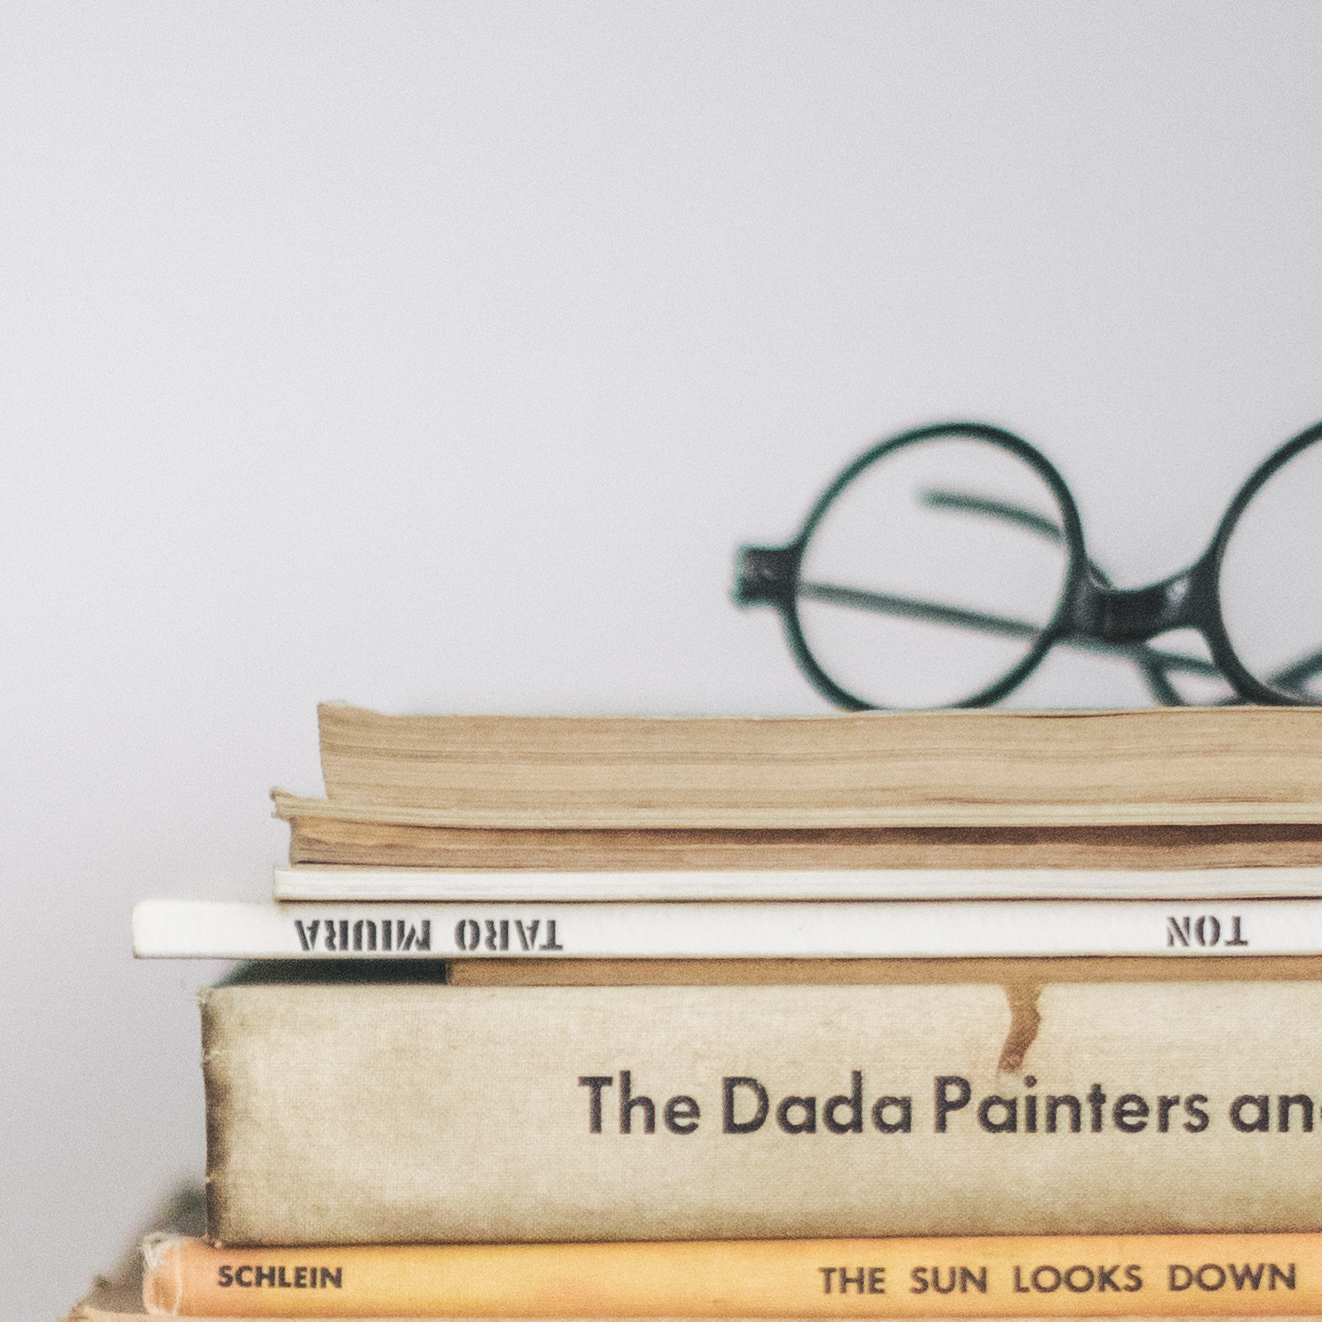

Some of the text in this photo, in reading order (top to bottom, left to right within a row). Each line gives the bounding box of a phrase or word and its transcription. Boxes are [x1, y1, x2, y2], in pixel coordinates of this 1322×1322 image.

[294, 919, 564, 952] TARO MIURA
[1166, 915, 1249, 947] TON
[578, 1070, 1322, 1135] The Dada Painters an
[218, 1265, 343, 1289] SCHLEIN
[819, 1263, 1297, 1294] THE SUN LOOKS DOWN
